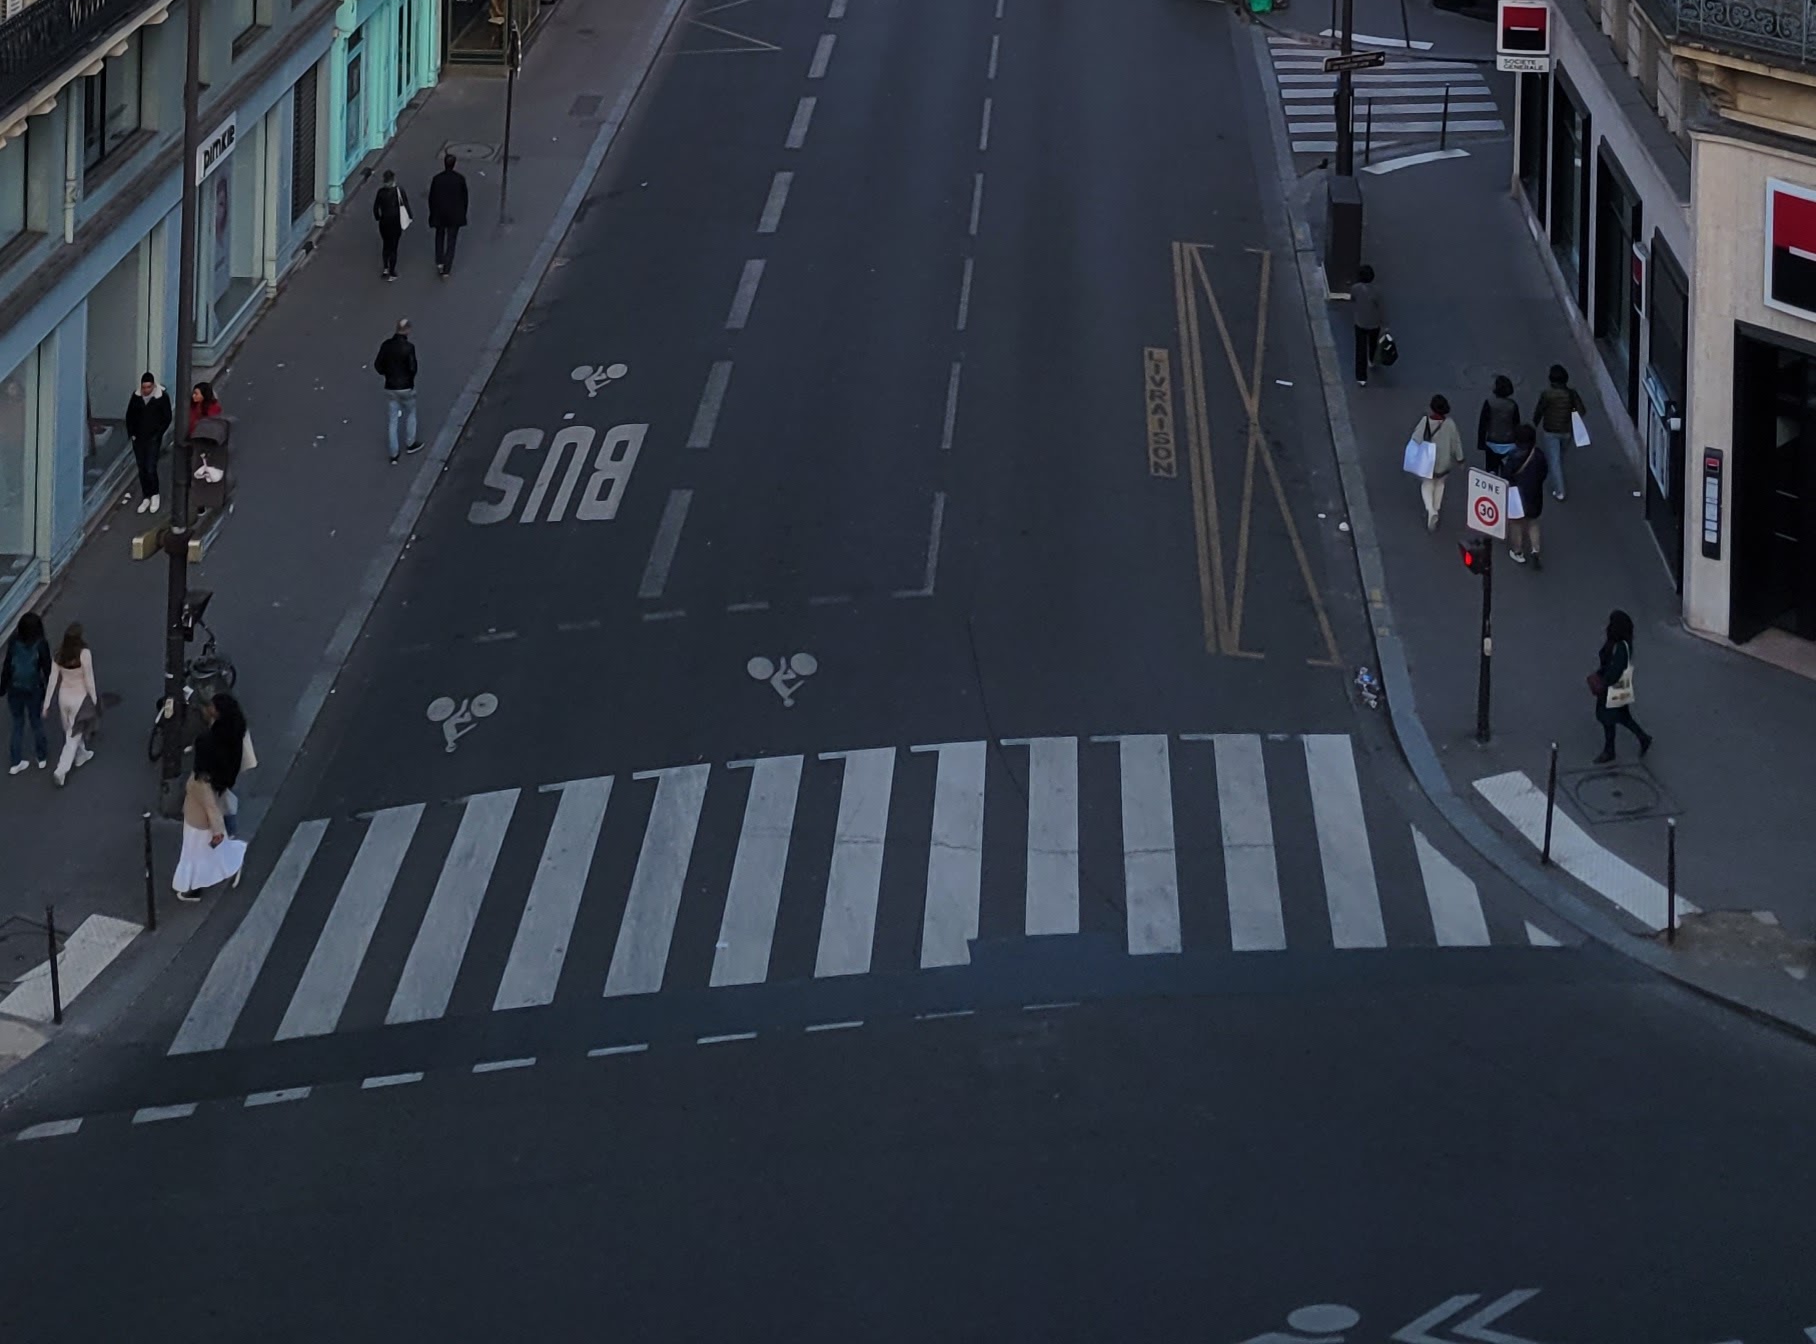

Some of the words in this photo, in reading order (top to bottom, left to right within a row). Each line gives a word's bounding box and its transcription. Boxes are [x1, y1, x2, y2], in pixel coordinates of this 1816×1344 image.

[467, 423, 650, 525] BUS
[1475, 478, 1500, 495] ZONE
[1480, 504, 1494, 519] 30
